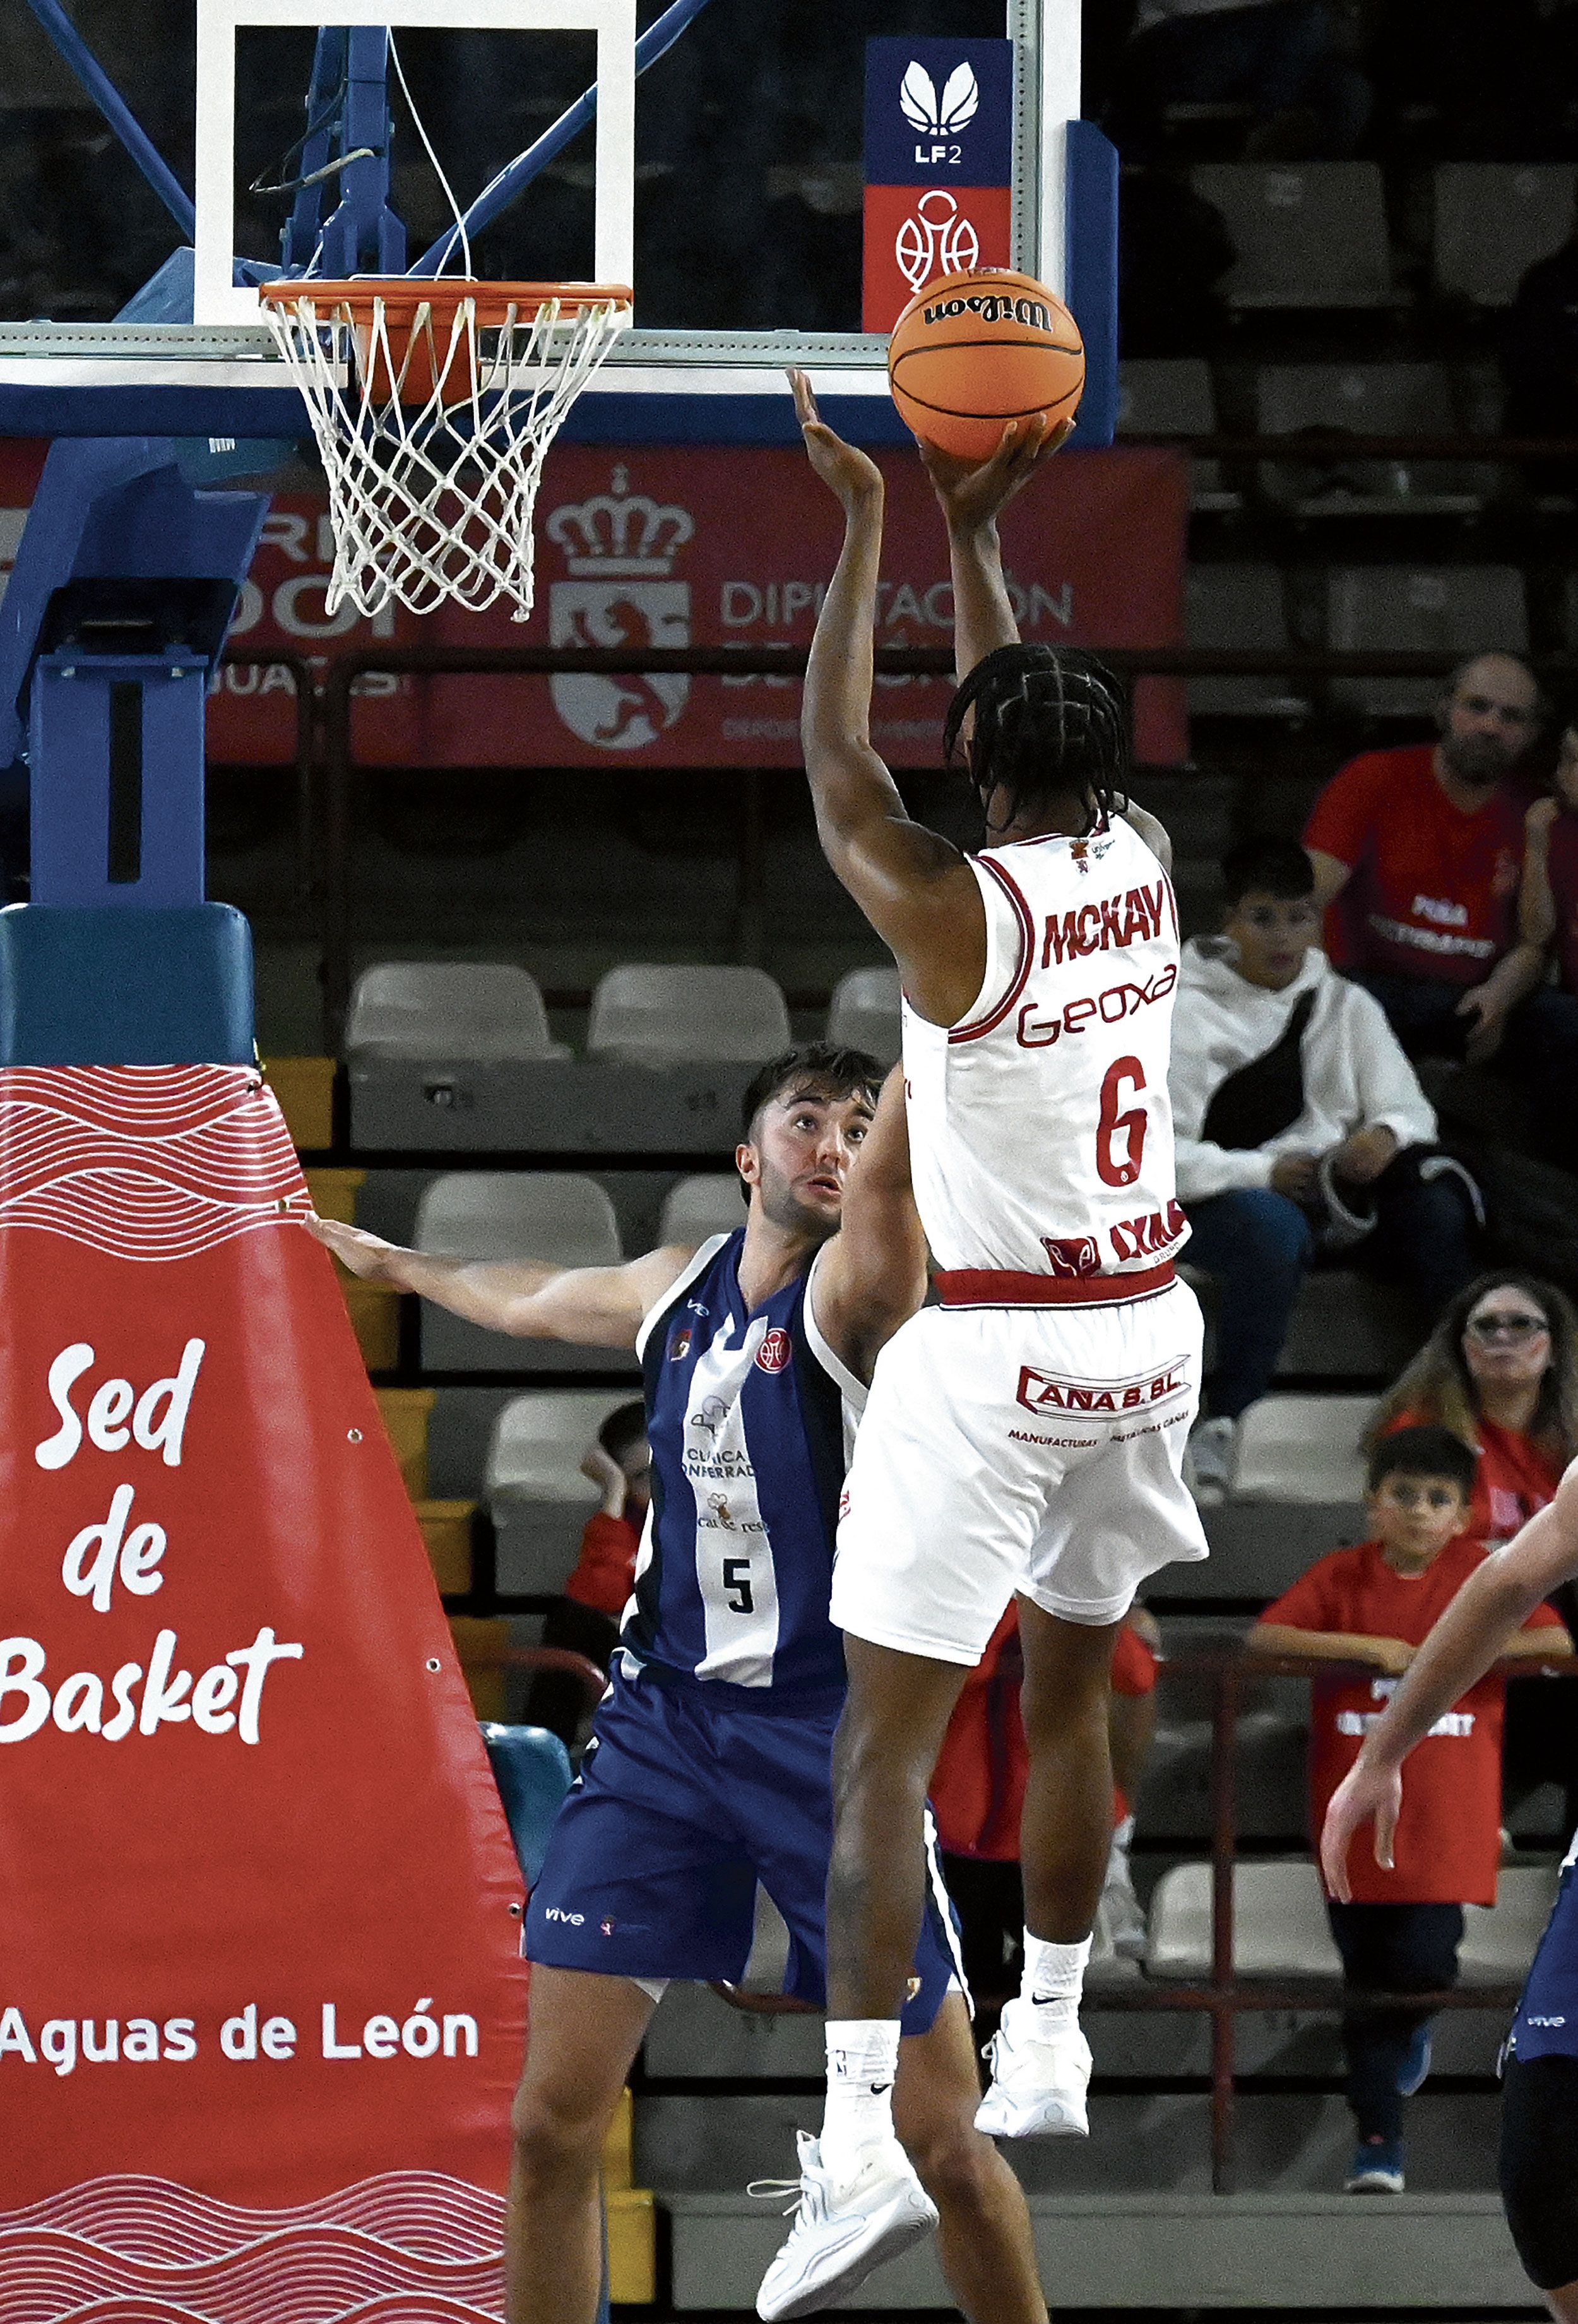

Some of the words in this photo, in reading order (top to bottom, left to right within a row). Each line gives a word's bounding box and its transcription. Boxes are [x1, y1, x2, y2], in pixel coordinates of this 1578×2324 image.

[915, 145, 961, 164] LF2
[923, 294, 1053, 333] Wilson
[721, 569, 1072, 628] DIPTACÓN
[1041, 879, 1163, 970] MCKAY
[1096, 1055, 1148, 1187] 6
[35, 1338, 206, 1470] Sed
[62, 1484, 167, 1612] de
[723, 1558, 754, 1614] 5
[0, 1627, 304, 1745] Basket
[0, 2006, 197, 2077] Aguas
[220, 2003, 297, 2060] de
[322, 1997, 478, 2059] León
